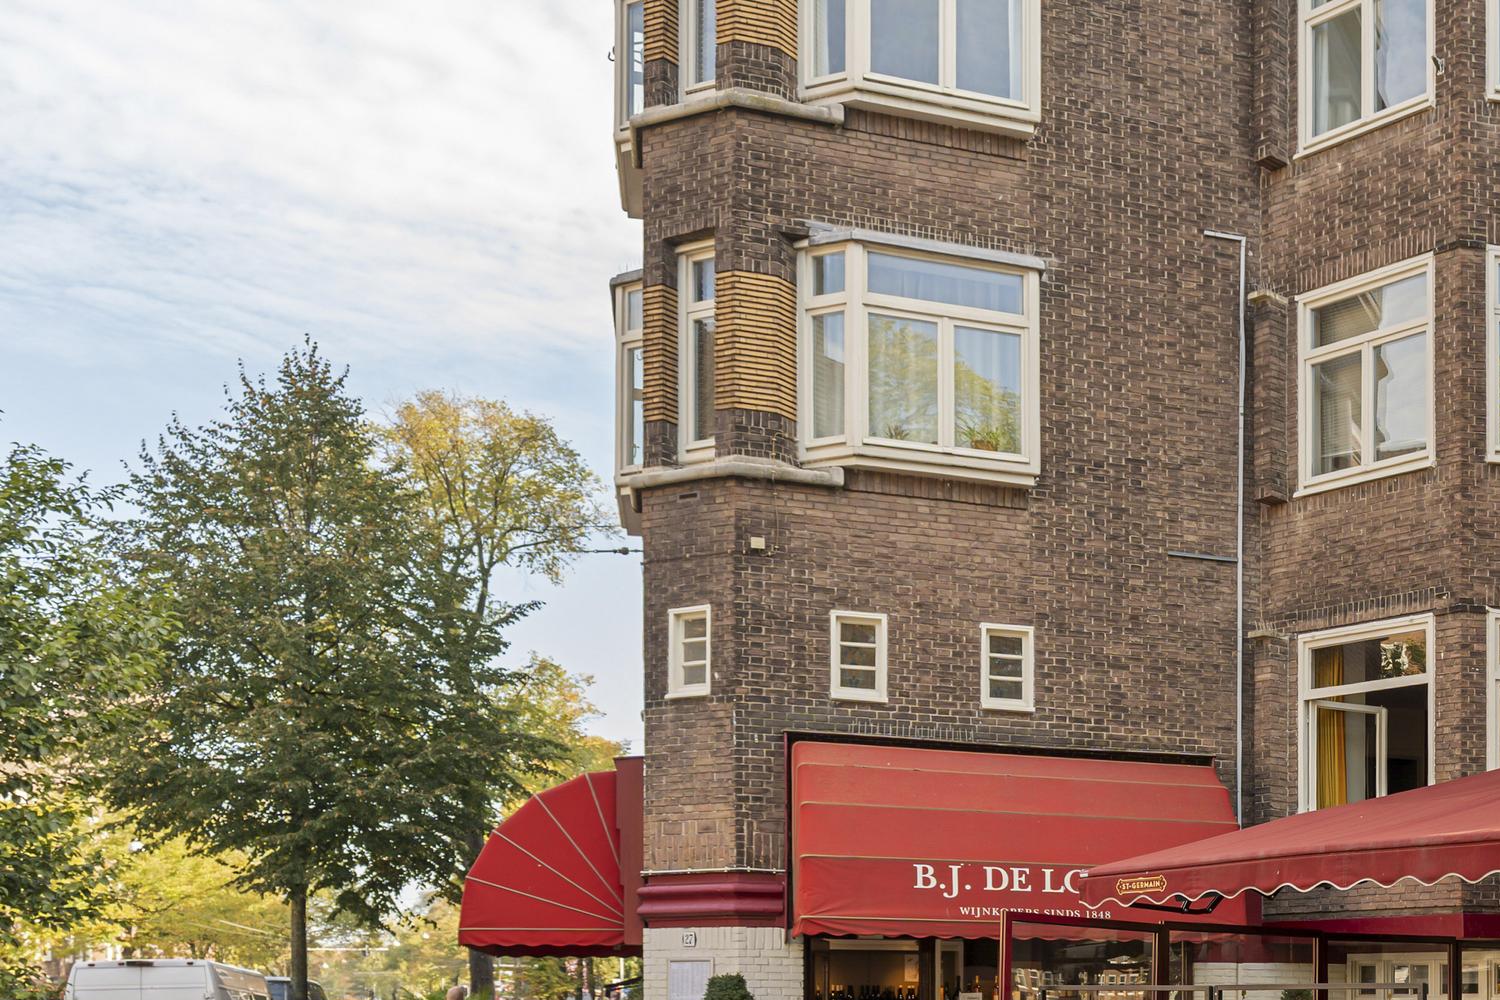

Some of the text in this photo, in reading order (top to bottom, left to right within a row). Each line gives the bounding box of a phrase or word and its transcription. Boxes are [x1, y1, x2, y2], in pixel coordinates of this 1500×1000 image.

[983, 866, 1032, 892] DE
[1122, 880, 1161, 890] ST-GERMAIN
[1085, 910, 1111, 919] 1848
